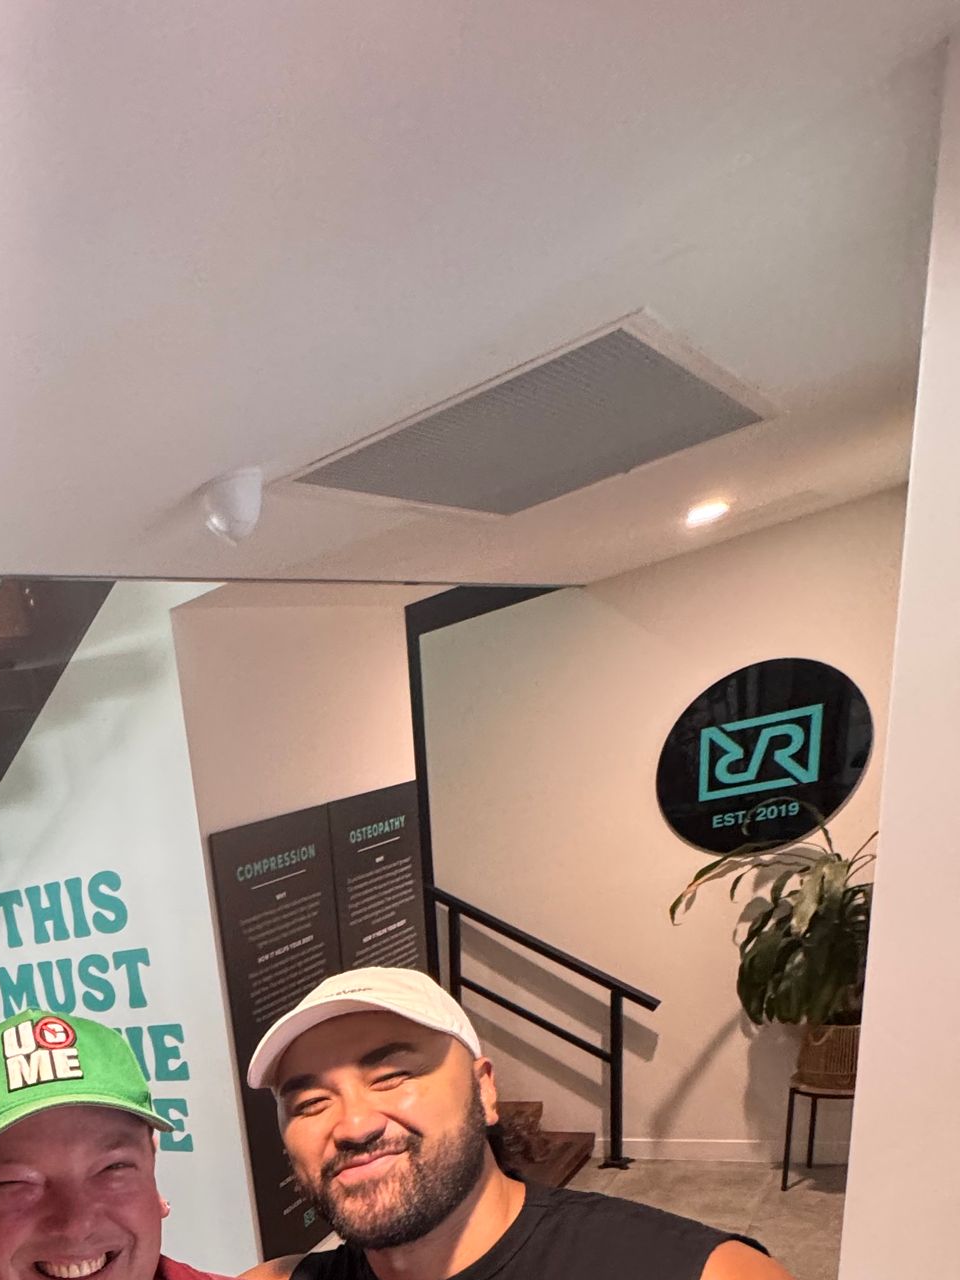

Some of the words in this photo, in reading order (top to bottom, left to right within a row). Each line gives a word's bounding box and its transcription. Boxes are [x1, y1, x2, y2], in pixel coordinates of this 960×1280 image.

[756, 801, 800, 822] 2019
[349, 815, 406, 843] OSTEOPATHY
[237, 844, 316, 882] COMPRESSION
[6, 1048, 84, 1090] ME
